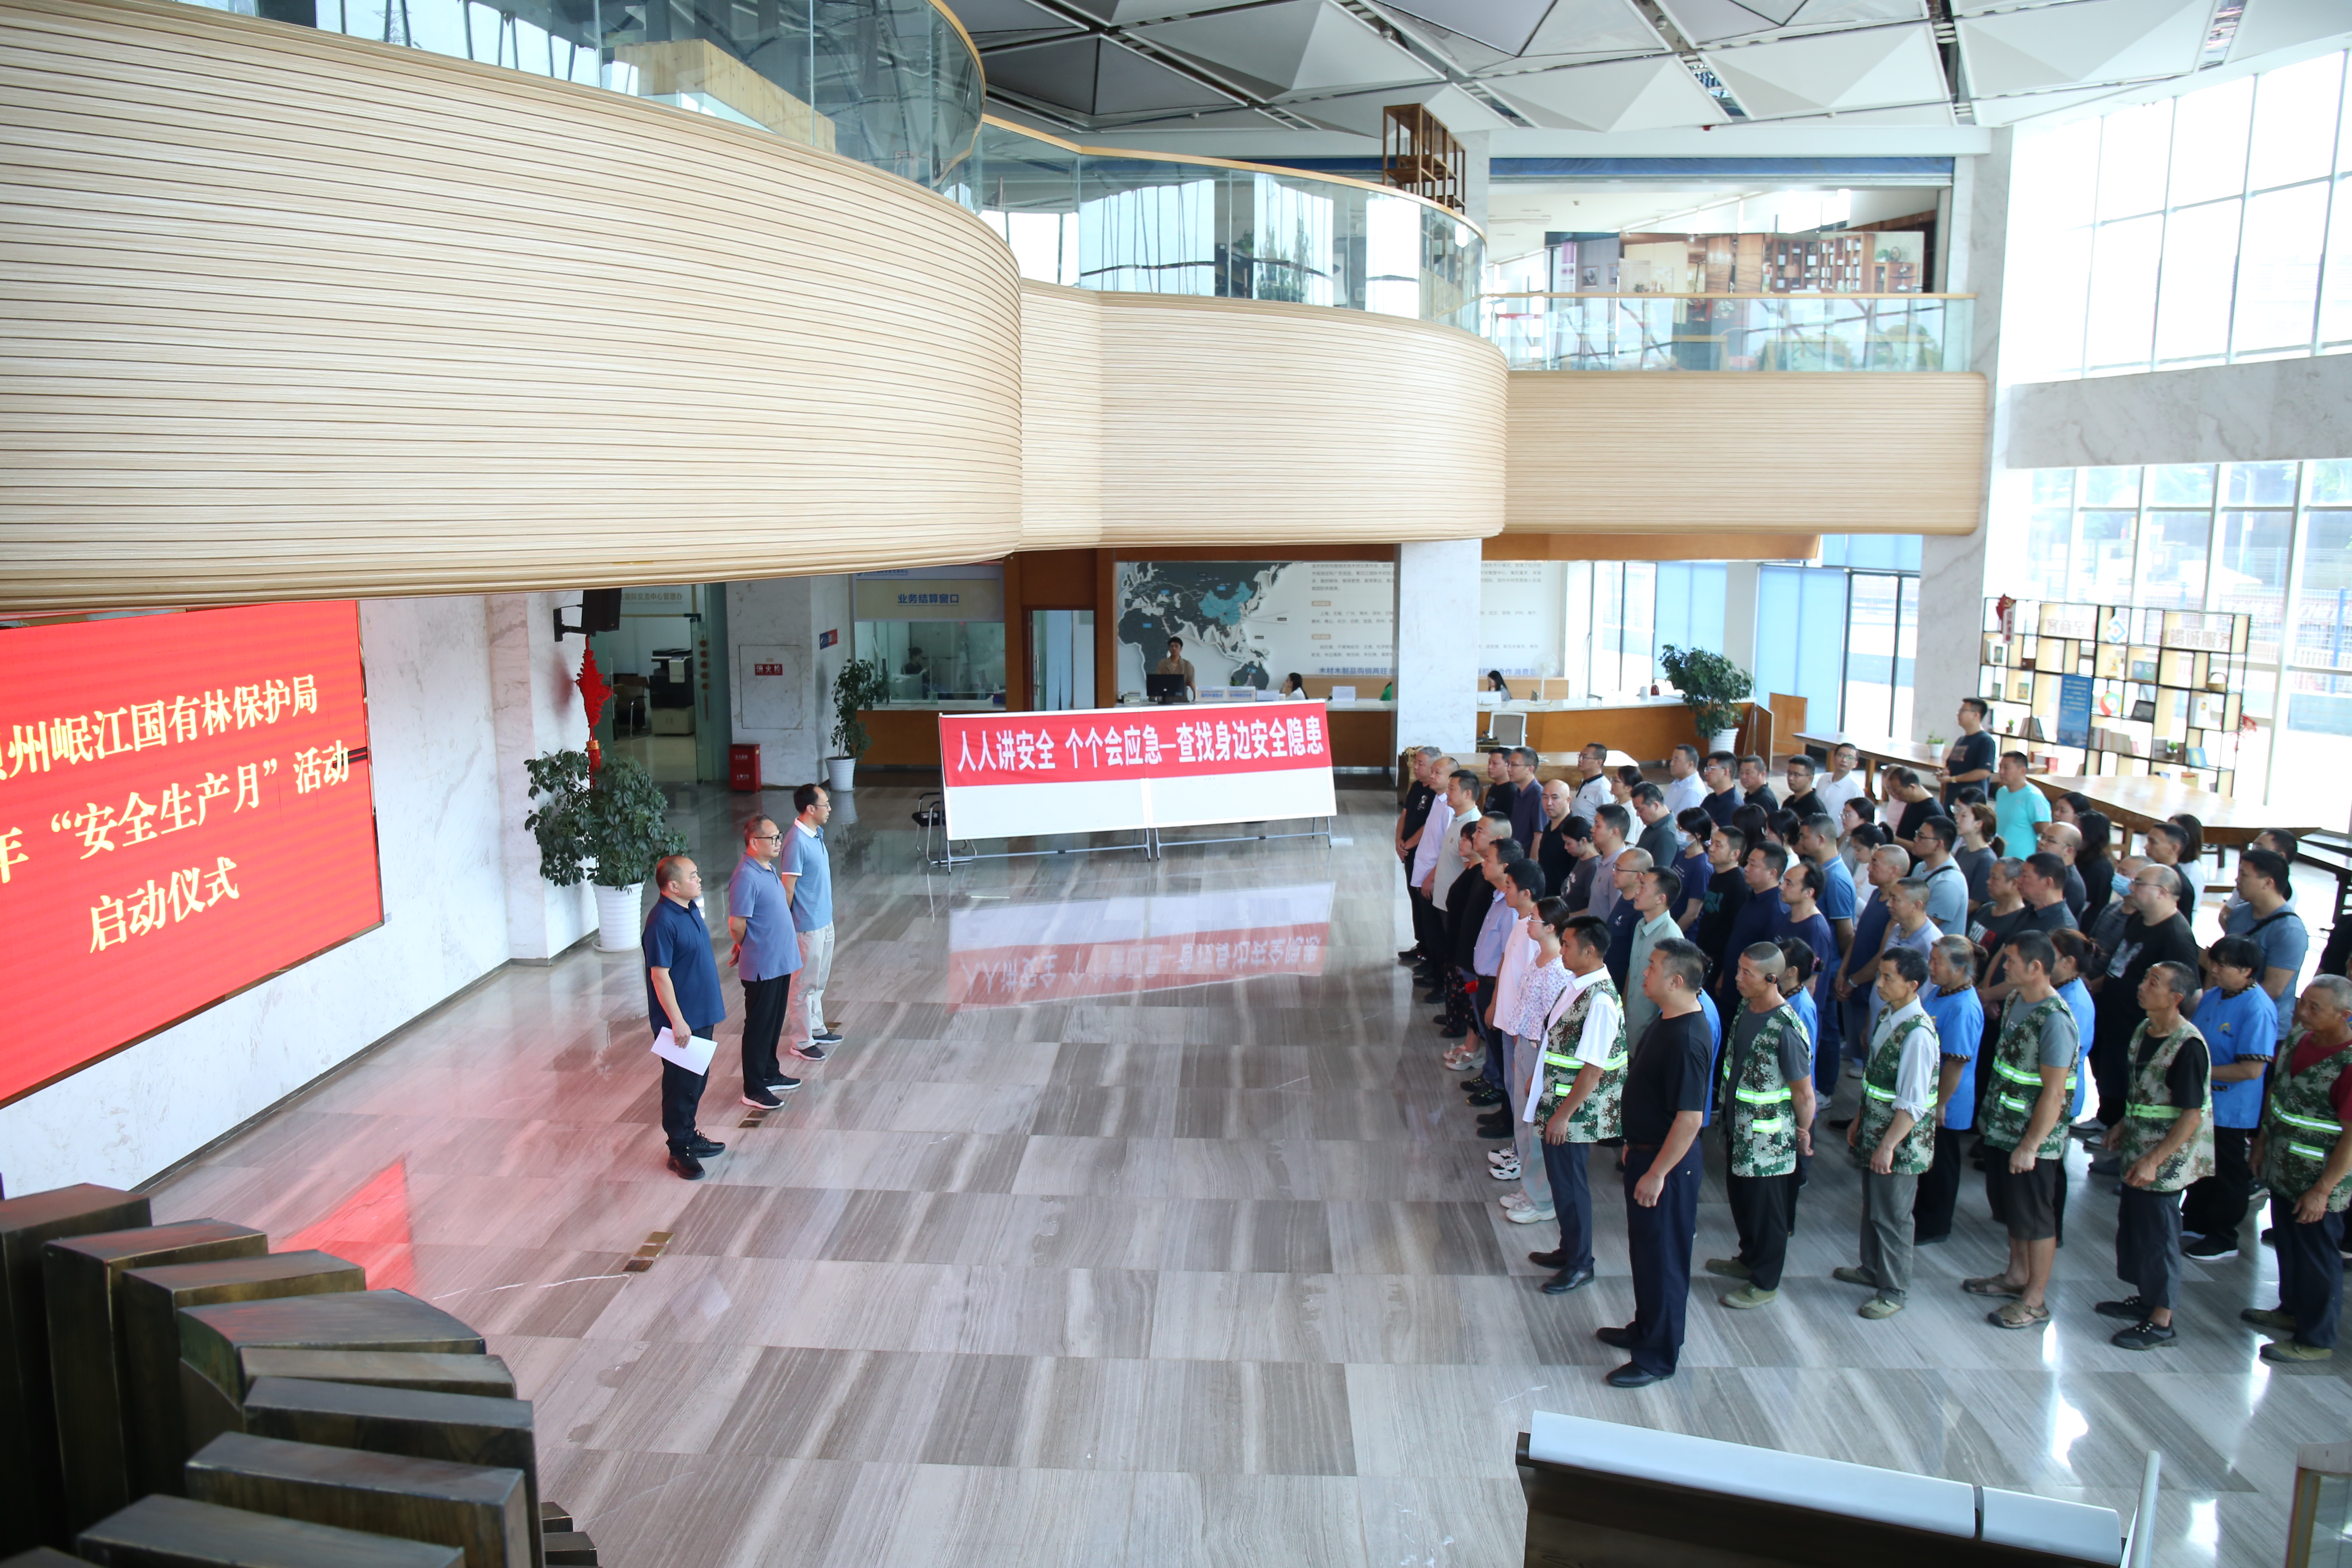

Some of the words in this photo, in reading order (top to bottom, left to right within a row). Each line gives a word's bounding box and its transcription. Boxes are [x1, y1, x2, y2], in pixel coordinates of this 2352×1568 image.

[897, 594, 959, 603] 业务结算窗口
[756, 665, 781, 674] 消火栓
[0, 674, 317, 781] 州岷江国有林保护局
[958, 729, 1056, 772] 人人讲安全
[90, 857, 239, 953] 启动仪式
